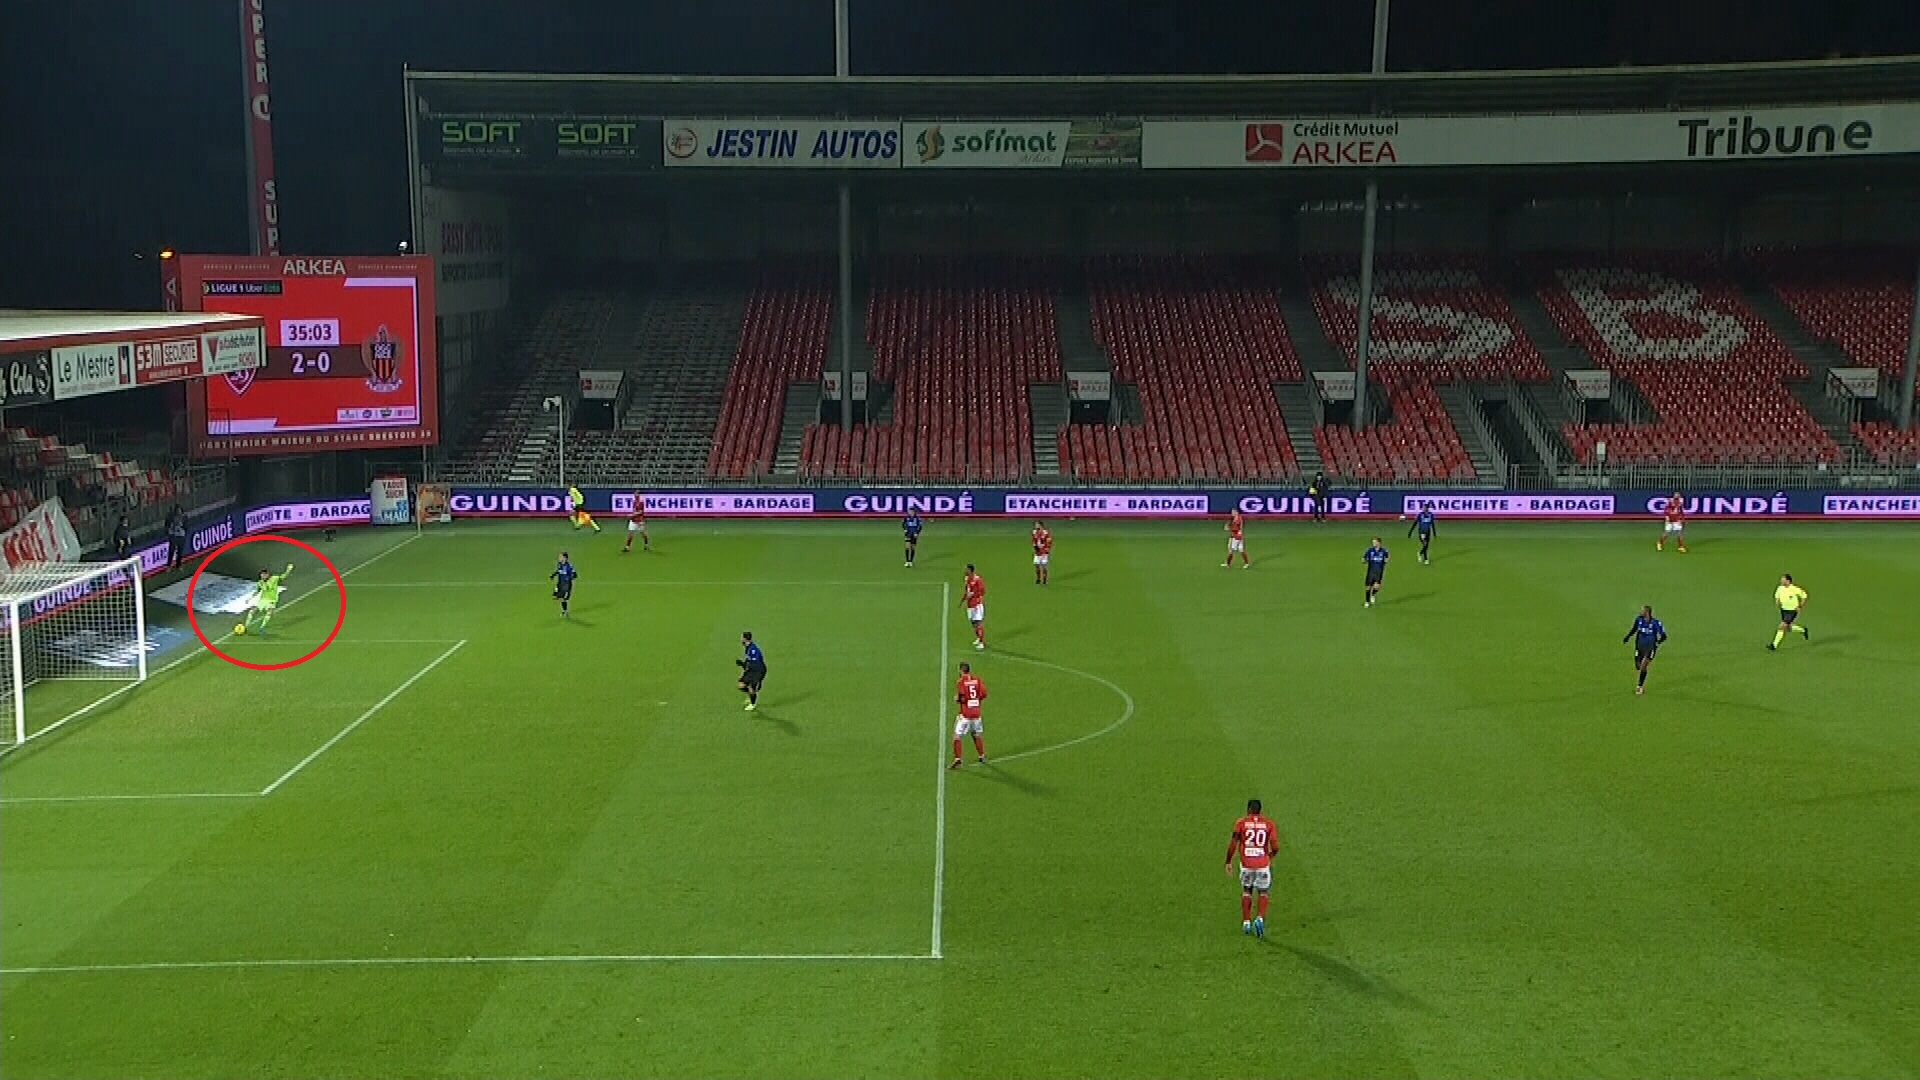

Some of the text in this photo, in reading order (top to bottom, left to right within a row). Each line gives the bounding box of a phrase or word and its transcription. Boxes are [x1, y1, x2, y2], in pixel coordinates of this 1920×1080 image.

[442, 121, 521, 143] SOFT
[558, 123, 636, 145] SOFT
[1293, 120, 1399, 137] Crédit Mutuel
[1678, 115, 1873, 157] Tribune
[706, 129, 898, 159] JESTIN AUTOS
[952, 128, 1057, 153] sofimat
[1293, 141, 1397, 165] ARKEA
[283, 260, 346, 275] ARKEA
[211, 283, 238, 293] LIGUE
[289, 323, 332, 341] 35:03
[57, 351, 71, 382] Le
[76, 354, 115, 381] Mestre
[292, 352, 330, 374] 2-0
[615, 497, 713, 509] ETNCHEITE
[733, 497, 811, 509] BARDAGE
[844, 491, 974, 513] GUINDÉ
[1008, 498, 1107, 510] ETANCHEITE
[1127, 498, 1205, 511] BARDAGE
[1407, 499, 1509, 511] ETANCHEITE
[1530, 499, 1611, 511] BARDAGE
[1827, 499, 1920, 511] ETANCHEI
[193, 515, 233, 551] GUINDÉ
[969, 685, 977, 699] 5
[1244, 829, 1267, 847] 20
